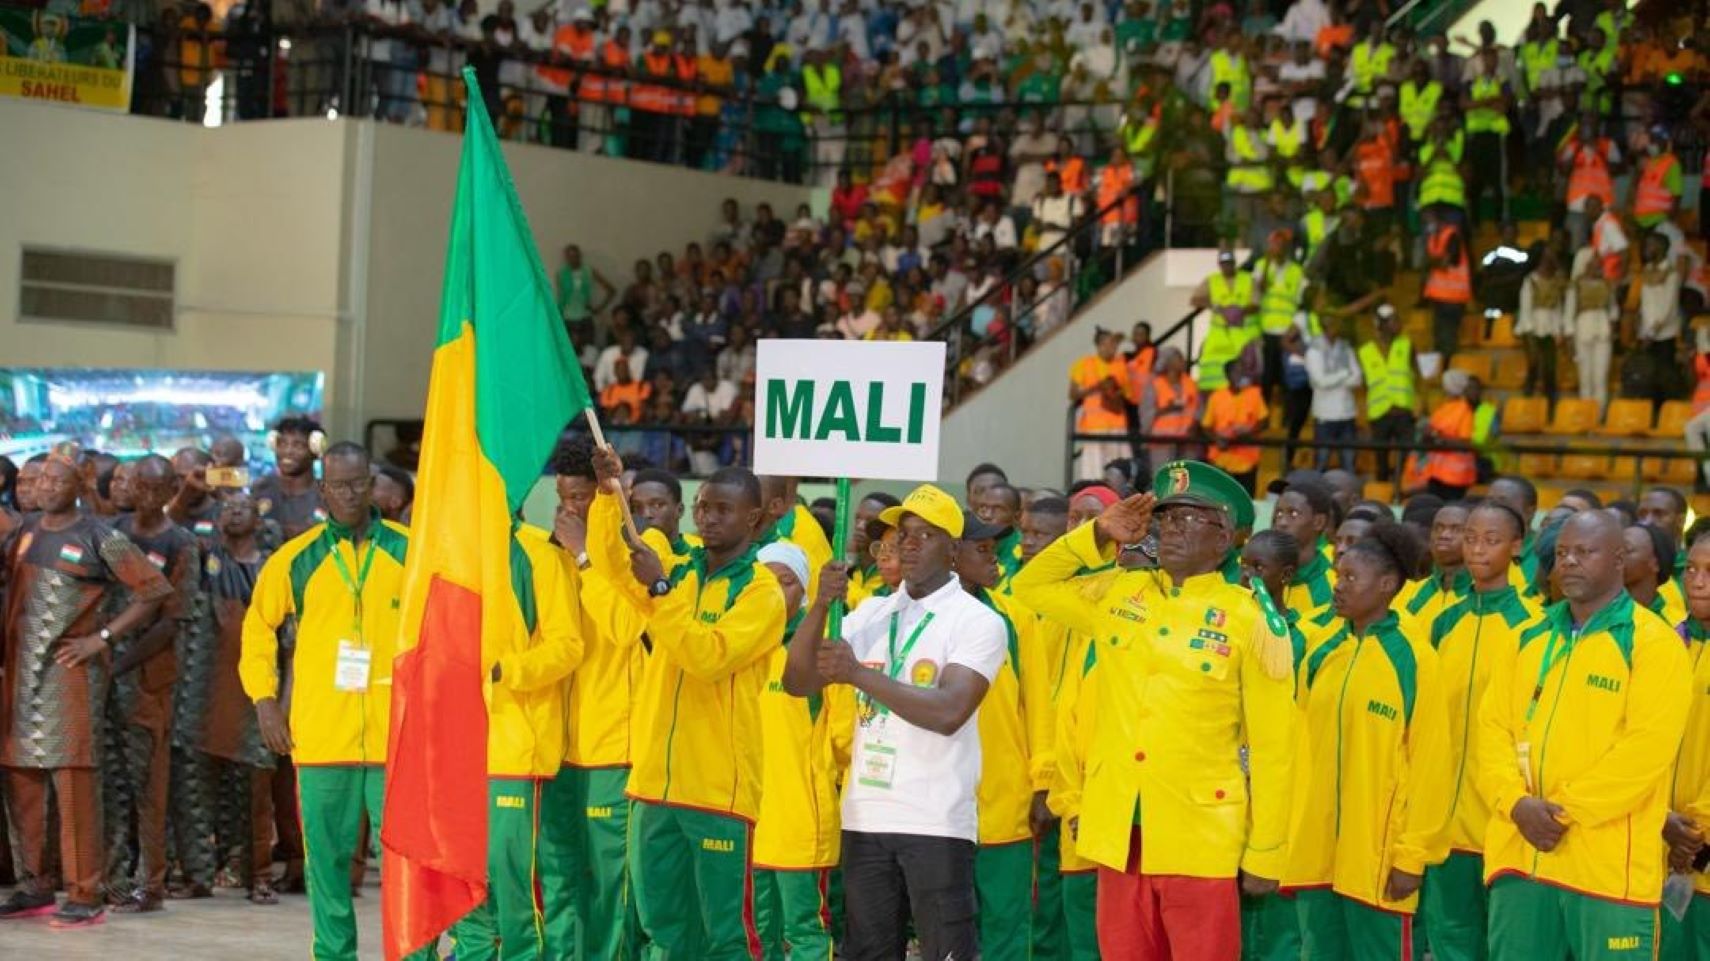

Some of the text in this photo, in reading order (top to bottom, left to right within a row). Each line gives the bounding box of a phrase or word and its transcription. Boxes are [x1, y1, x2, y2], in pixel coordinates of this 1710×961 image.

[21, 79, 81, 104] SAHEL
[765, 378, 926, 444] MALI
[768, 680, 785, 692] MA
[1587, 673, 1621, 692] MALI
[1368, 699, 1397, 720] MALI
[496, 796, 525, 809] MALI
[587, 806, 612, 817] MALI
[702, 838, 734, 852] MALI
[1607, 936, 1639, 950] MALI
